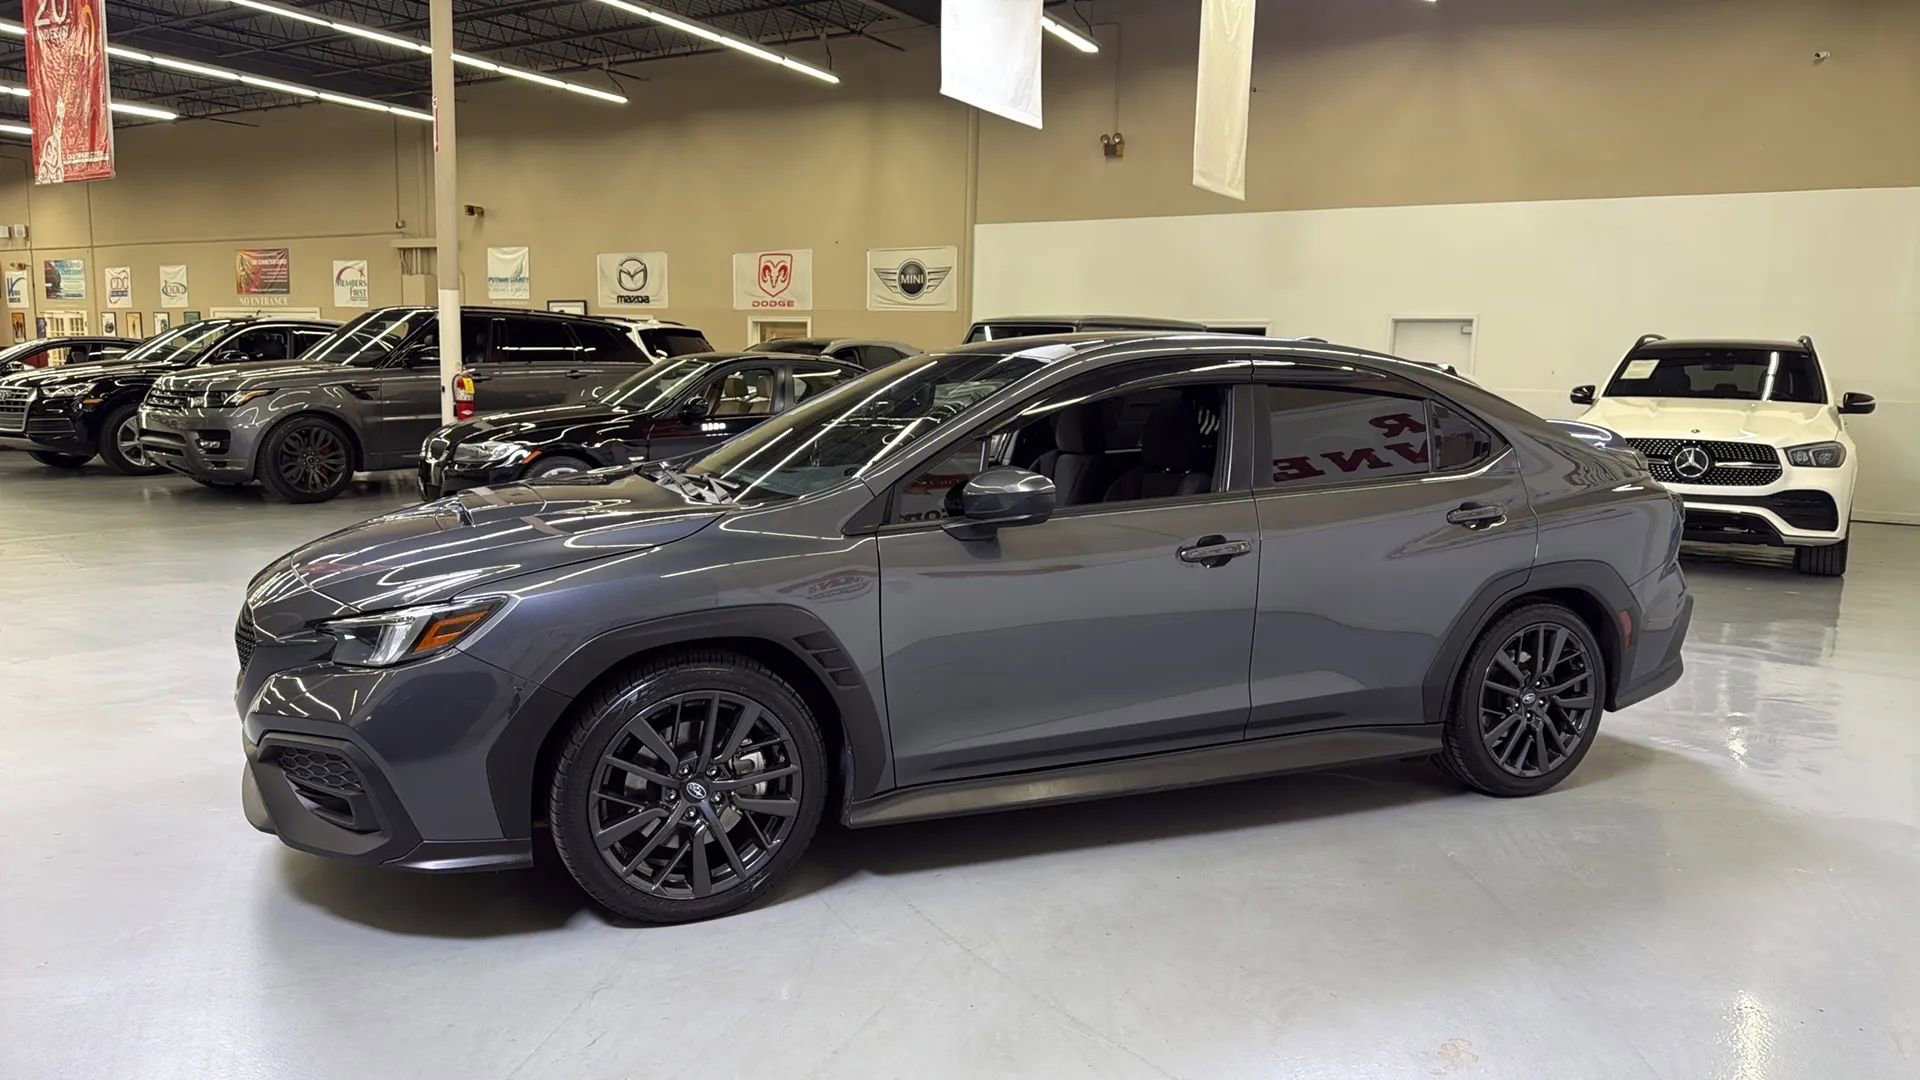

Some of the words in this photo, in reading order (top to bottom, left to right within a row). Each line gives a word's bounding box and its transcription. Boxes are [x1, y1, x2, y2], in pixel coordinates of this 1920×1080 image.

[901, 274, 924, 284] MINI
[240, 296, 250, 305] NO
[251, 296, 288, 306] ENTRANCE
